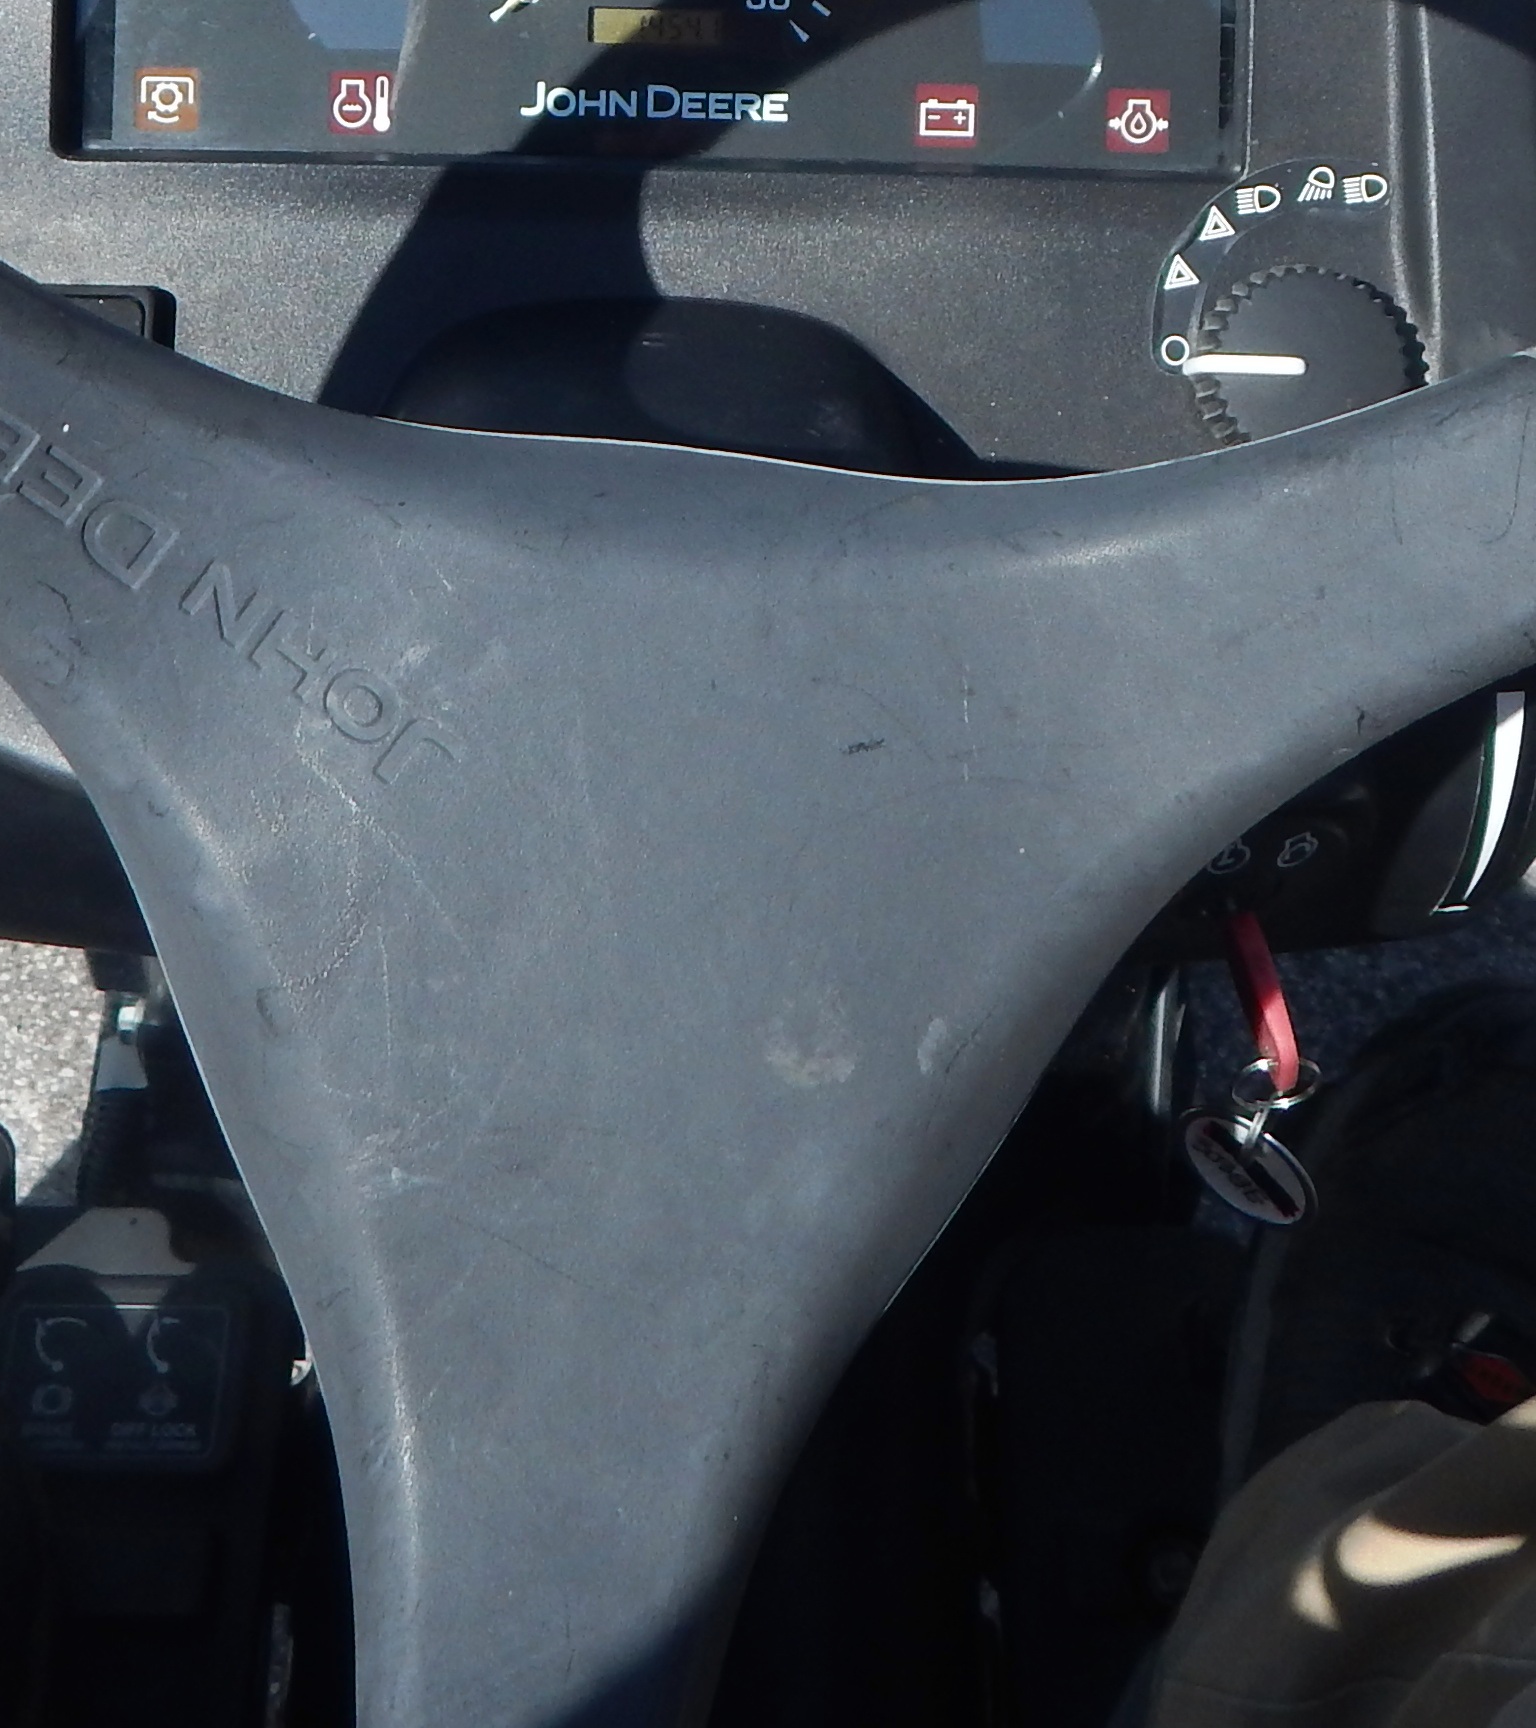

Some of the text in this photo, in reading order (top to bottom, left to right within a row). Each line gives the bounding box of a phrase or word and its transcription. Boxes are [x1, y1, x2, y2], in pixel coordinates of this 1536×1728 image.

[520, 81, 789, 122] JOHN DEERE
[175, 556, 458, 785] JOHN
